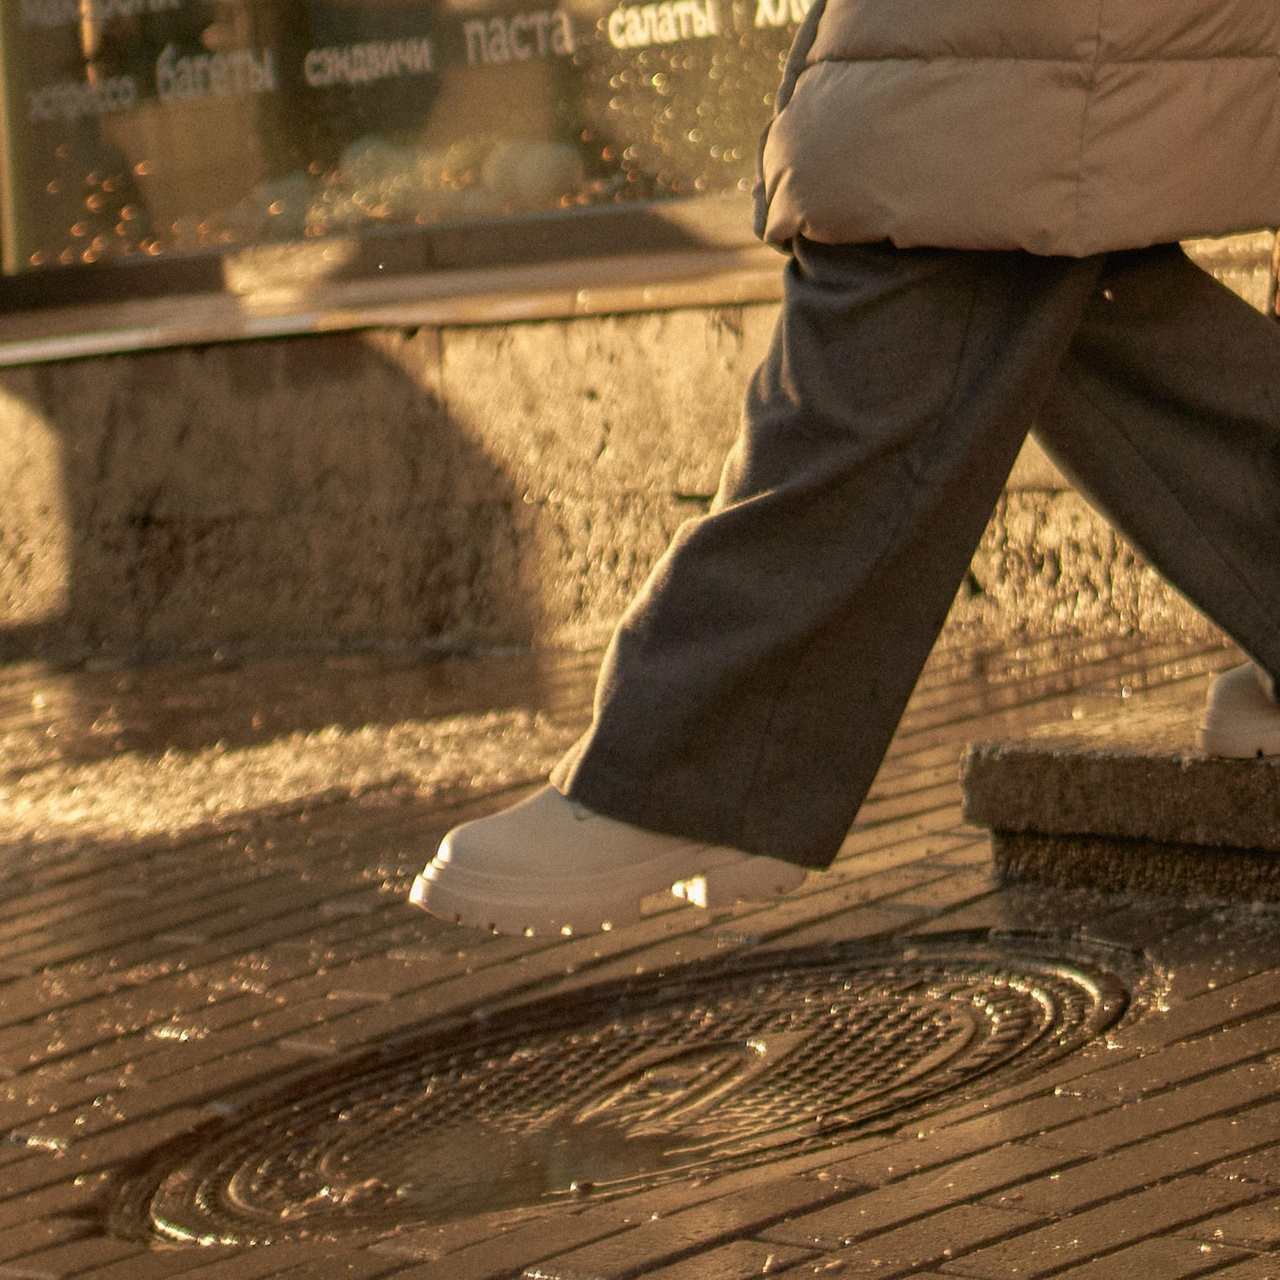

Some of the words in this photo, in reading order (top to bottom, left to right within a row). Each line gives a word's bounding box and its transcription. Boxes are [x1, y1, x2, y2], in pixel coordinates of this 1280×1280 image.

[155, 44, 276, 104] багеты
[304, 40, 434, 89] сэндвичи
[463, 9, 575, 66] паста
